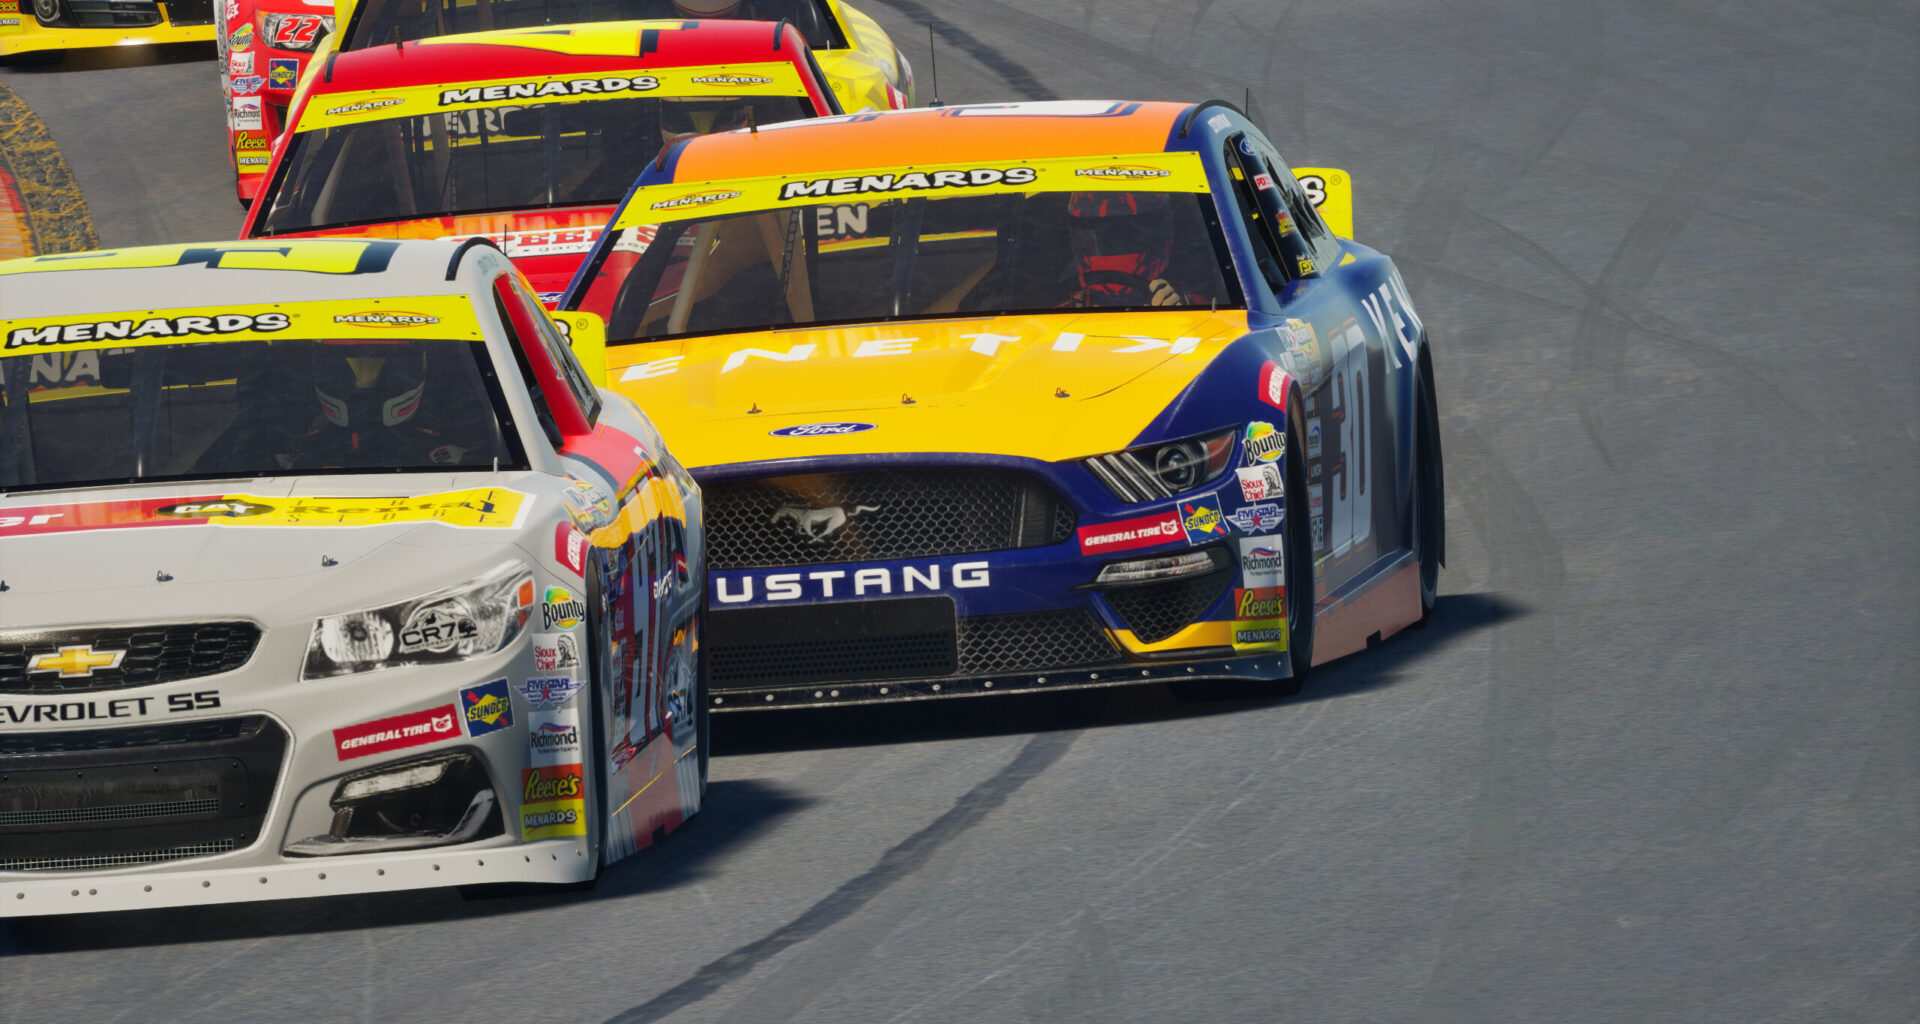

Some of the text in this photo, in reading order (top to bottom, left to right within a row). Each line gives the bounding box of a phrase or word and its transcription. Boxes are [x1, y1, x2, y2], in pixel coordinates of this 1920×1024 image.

[275, 18, 322, 42] 22
[692, 76, 773, 84] MENARDS
[438, 76, 659, 106] MENARDS
[326, 98, 405, 115] MENARDS
[237, 131, 267, 150] Reese's
[239, 157, 269, 166] MENARDS
[1075, 168, 1171, 178] MENARDS
[778, 168, 1037, 201] MENARDS
[650, 191, 741, 210] MENARDS
[333, 315, 440, 324] MENARDS
[4, 313, 291, 349] MENARDS
[788, 422, 857, 436] Ford
[1243, 432, 1286, 465] Bounty
[1241, 479, 1264, 490] Sioux
[1244, 489, 1265, 501] Chief
[1188, 510, 1220, 530] SUNOCO
[1238, 505, 1278, 521] FIVE STAR
[1085, 526, 1161, 546] GENERAL TIRE
[1243, 551, 1282, 571] Richmond
[716, 561, 990, 603] USTANG
[1239, 590, 1284, 618] Reese's
[542, 600, 585, 631] Bounty
[402, 622, 456, 646] CR7
[1237, 628, 1281, 643] MENARDS
[535, 646, 557, 658] Sioux
[536, 659, 556, 671] Chief
[527, 678, 570, 691] FIVE STAR
[168, 690, 221, 712] SS
[469, 697, 509, 722] SUNOCO
[341, 723, 431, 750] GENERAL TIRE
[531, 727, 577, 747] Richmond
[525, 769, 582, 799] Reese's
[525, 808, 577, 826] MENARDS
